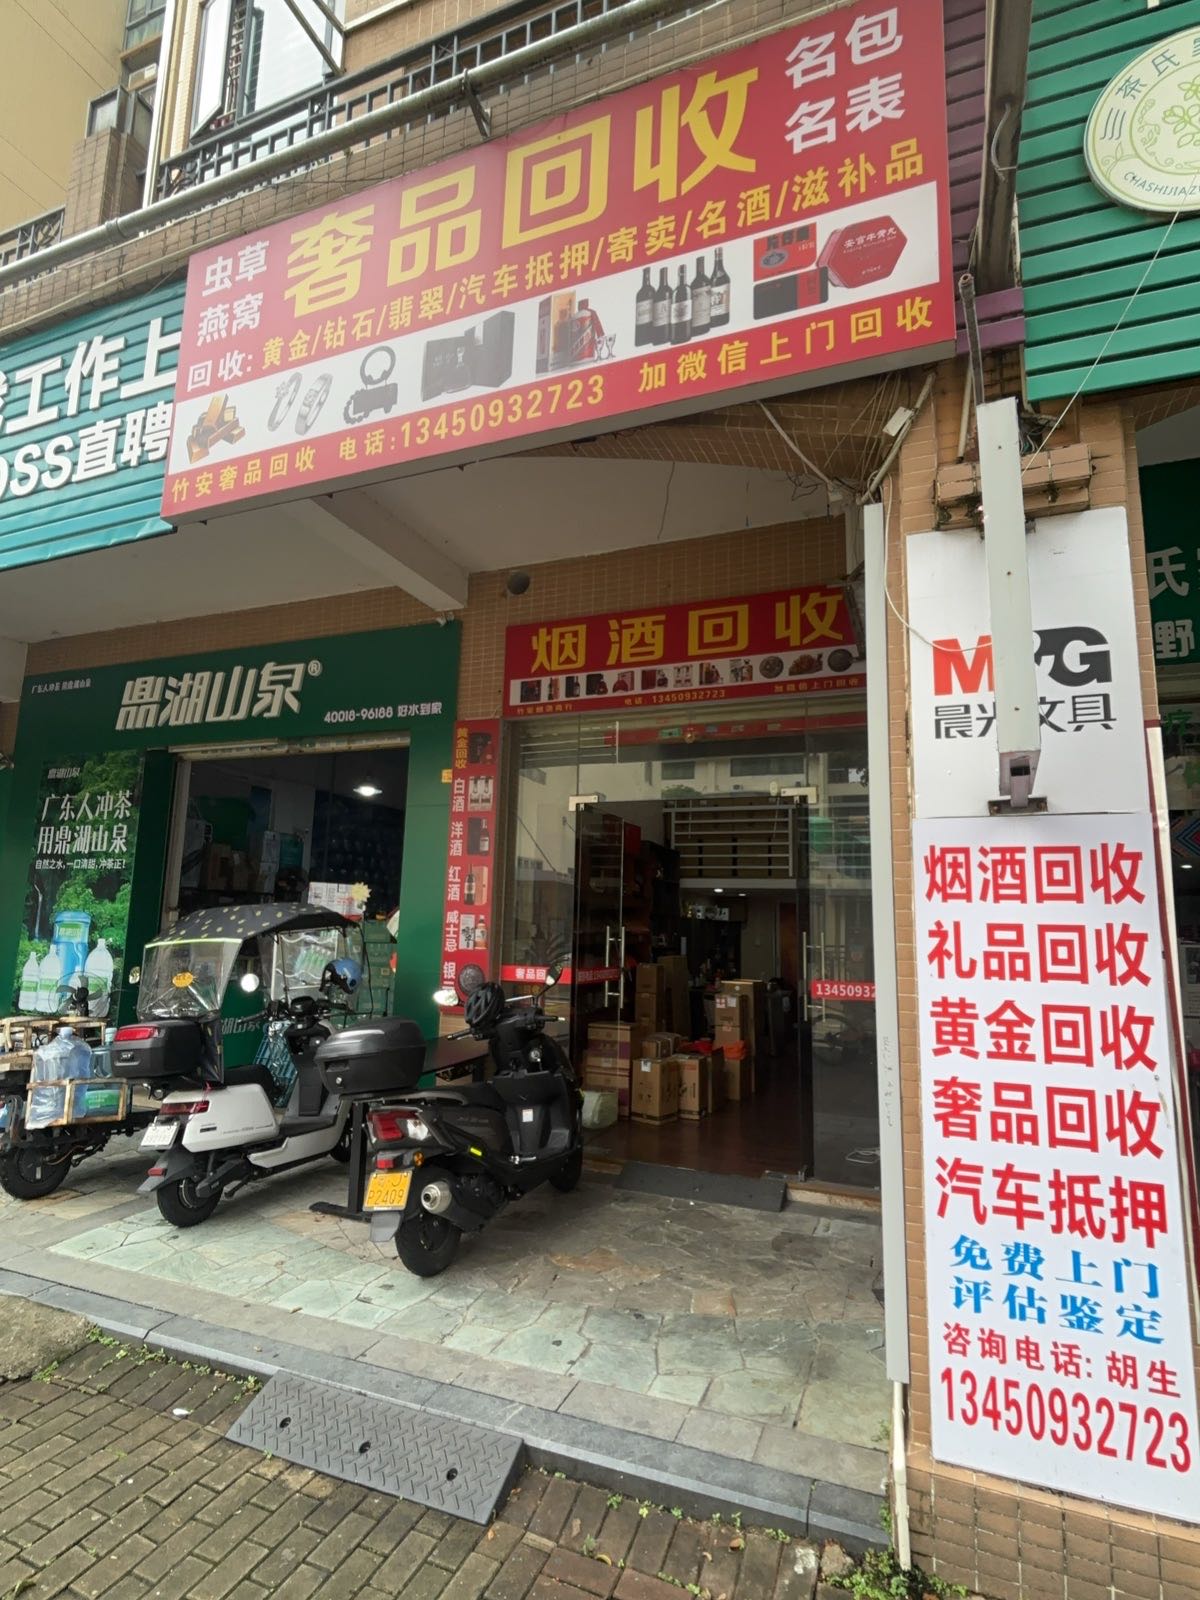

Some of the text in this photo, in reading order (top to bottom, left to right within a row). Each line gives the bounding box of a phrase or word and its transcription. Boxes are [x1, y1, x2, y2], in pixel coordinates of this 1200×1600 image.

[785, 7, 902, 89] 名包
[785, 72, 905, 154] 名表
[284, 67, 758, 317] 奢品回收
[202, 240, 270, 297] 虫草
[197, 293, 263, 347] 燕窝
[171, 446, 315, 503] 竹安奢品回收
[639, 297, 932, 392] 加微信上门回收
[1147, 546, 1200, 599] 氏
[531, 592, 844, 674] 烟酒回收
[324, 700, 442, 724] 40018-96188 好水到家
[454, 727, 468, 769] 黄金回收
[41, 790, 133, 822] 广东人冲茶
[452, 778, 465, 812] 白酒
[37, 823, 127, 855] 用鼎湖山泉
[450, 821, 464, 857] 洋酒
[447, 865, 461, 902] 红酒
[924, 842, 1146, 905] 烟酒回收
[927, 920, 1151, 987] 礼品回收
[930, 996, 1158, 1072] 黄金回收
[933, 1076, 1164, 1159] 奢品回收
[367, 1188, 405, 1206] P2409
[935, 1156, 1168, 1249] 汽车抵押
[950, 1234, 1160, 1299] 免费上门
[950, 1276, 1165, 1345] 评估鉴定
[940, 1367, 1191, 1473] 13450932723
